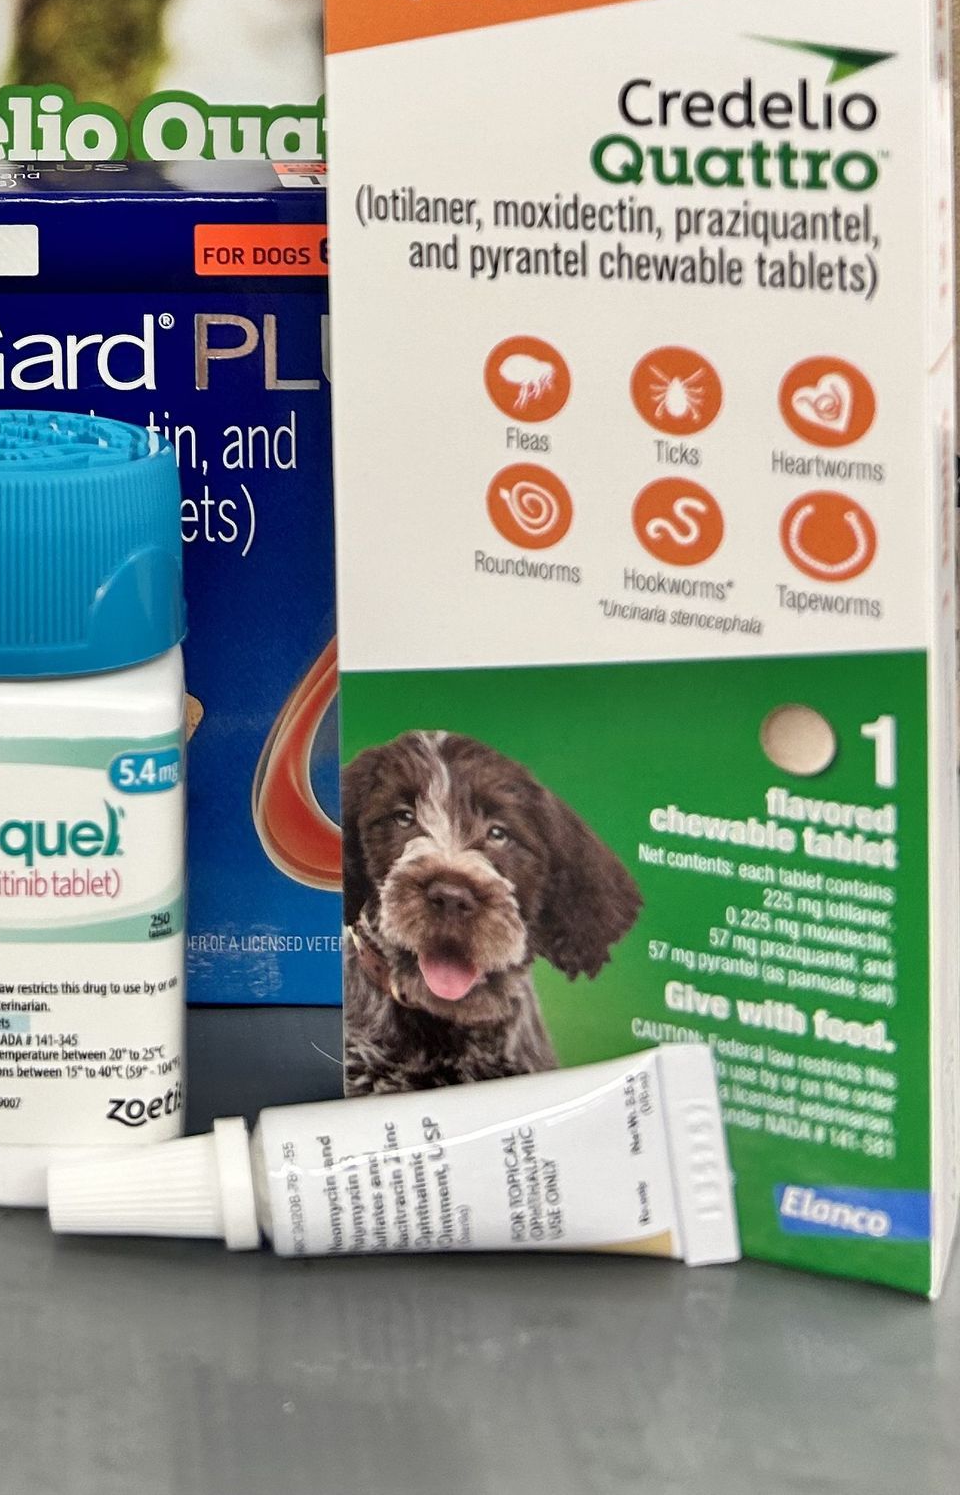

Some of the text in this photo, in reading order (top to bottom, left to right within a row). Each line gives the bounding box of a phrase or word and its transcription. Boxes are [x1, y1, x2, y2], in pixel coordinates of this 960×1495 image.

[617, 77, 878, 132] Credelio
[354, 183, 882, 250] (lotilaner, moxidectin, praziquantel,
[203, 247, 245, 265] FOR
[252, 247, 311, 265] DOGS
[408, 239, 880, 301] and pyrantel chewable tablets)
[223, 410, 297, 470] and
[505, 427, 550, 453] Fleas
[653, 439, 700, 467] Ticks
[772, 449, 885, 481] Heartworms
[474, 550, 581, 585] Roundworms
[776, 584, 882, 618] Tapeworms
[669, 608, 763, 636] stenocephala
[861, 714, 897, 789] 1
[119, 758, 155, 785] 5.4
[765, 786, 896, 834] flavored
[649, 804, 898, 870] chewable tablet
[52, 868, 122, 899] tablet)
[150, 912, 170, 928] 250
[664, 981, 896, 1054] Give with food.
[780, 1185, 889, 1237] Elanco
